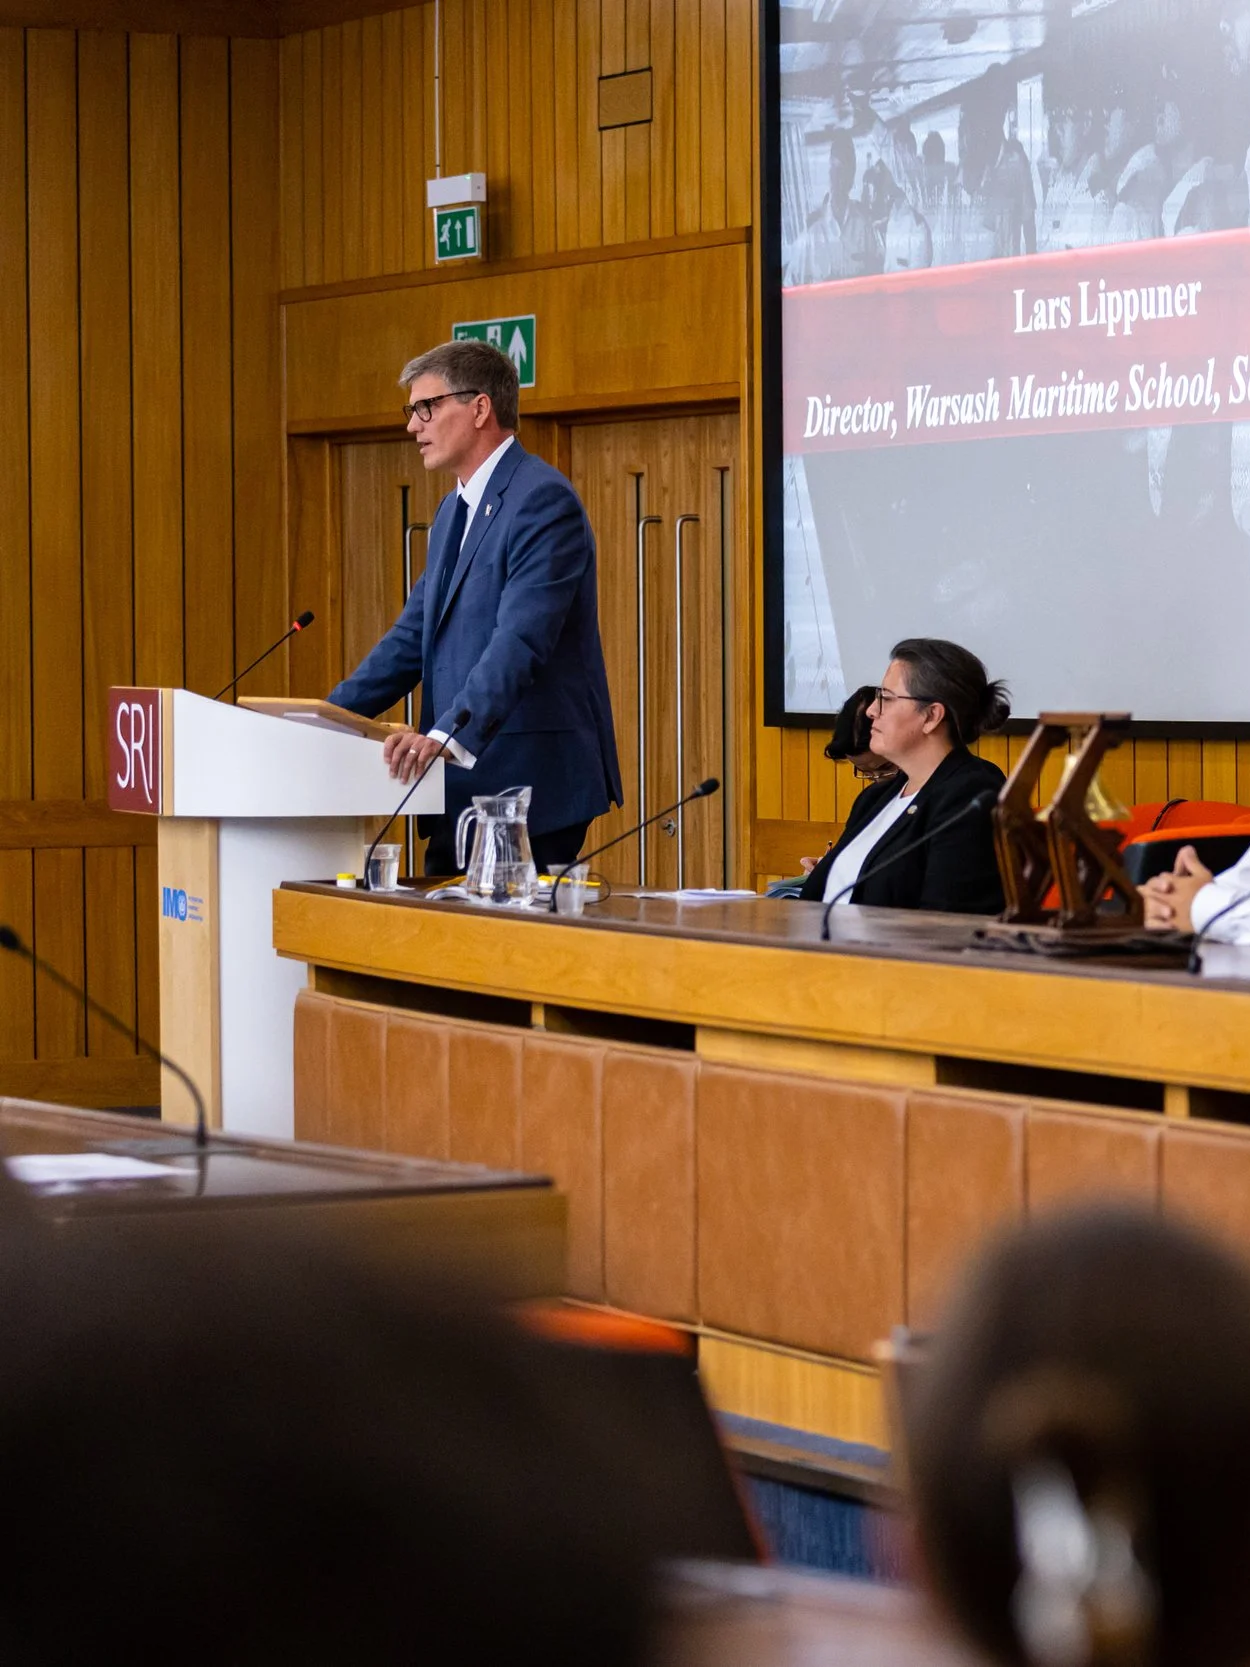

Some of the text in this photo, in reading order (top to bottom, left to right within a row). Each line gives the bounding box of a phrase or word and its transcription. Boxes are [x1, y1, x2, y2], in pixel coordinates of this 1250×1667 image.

[1012, 279, 1203, 338] Lars Lippuner
[802, 393, 898, 440] Director,
[905, 376, 1000, 430] Warsash
[1005, 368, 1120, 421] Maritime
[1124, 356, 1221, 416] School,
[116, 701, 153, 804] SRI
[162, 886, 188, 922] IMO
